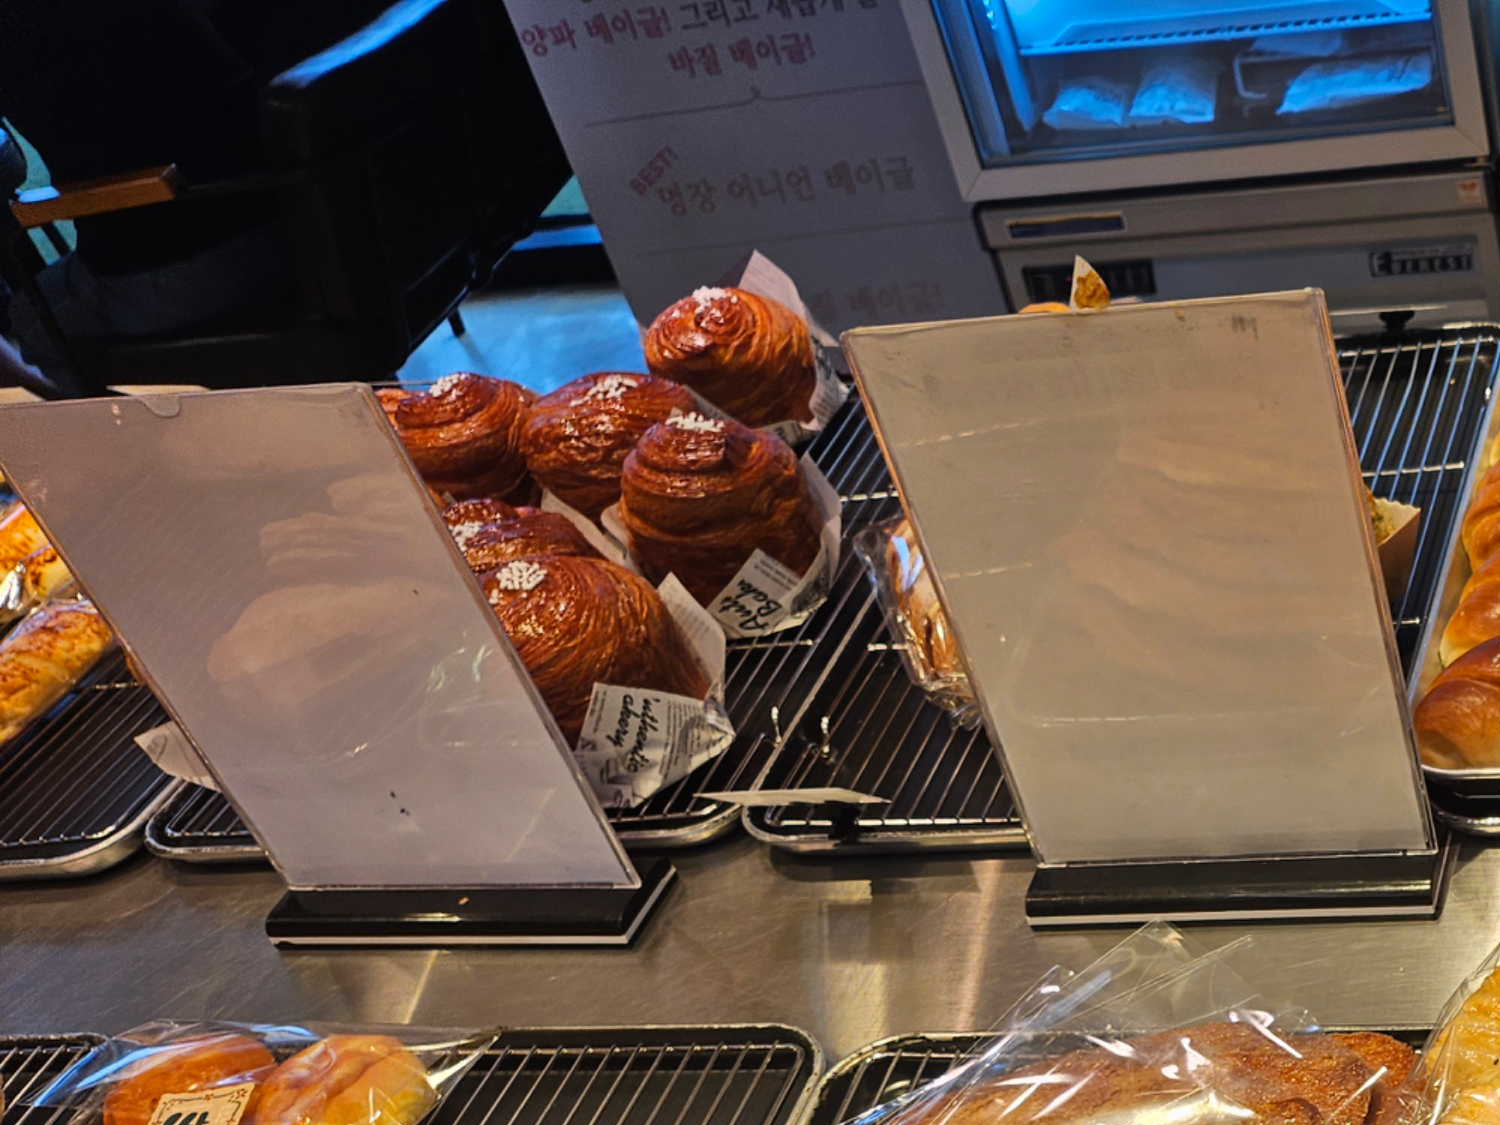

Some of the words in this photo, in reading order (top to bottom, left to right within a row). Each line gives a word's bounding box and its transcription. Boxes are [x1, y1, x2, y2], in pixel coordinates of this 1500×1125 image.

[520, 19, 577, 58] 양파
[584, 5, 672, 46] 베이글!
[680, 0, 758, 31] 그리고
[668, 42, 724, 79] 바질
[728, 32, 816, 72] 베이글!
[628, 144, 678, 196] BEST!
[658, 177, 716, 218] 명장
[726, 164, 817, 208] 어니언
[824, 154, 916, 196] 베이글
[626, 695, 663, 774] uthentic
